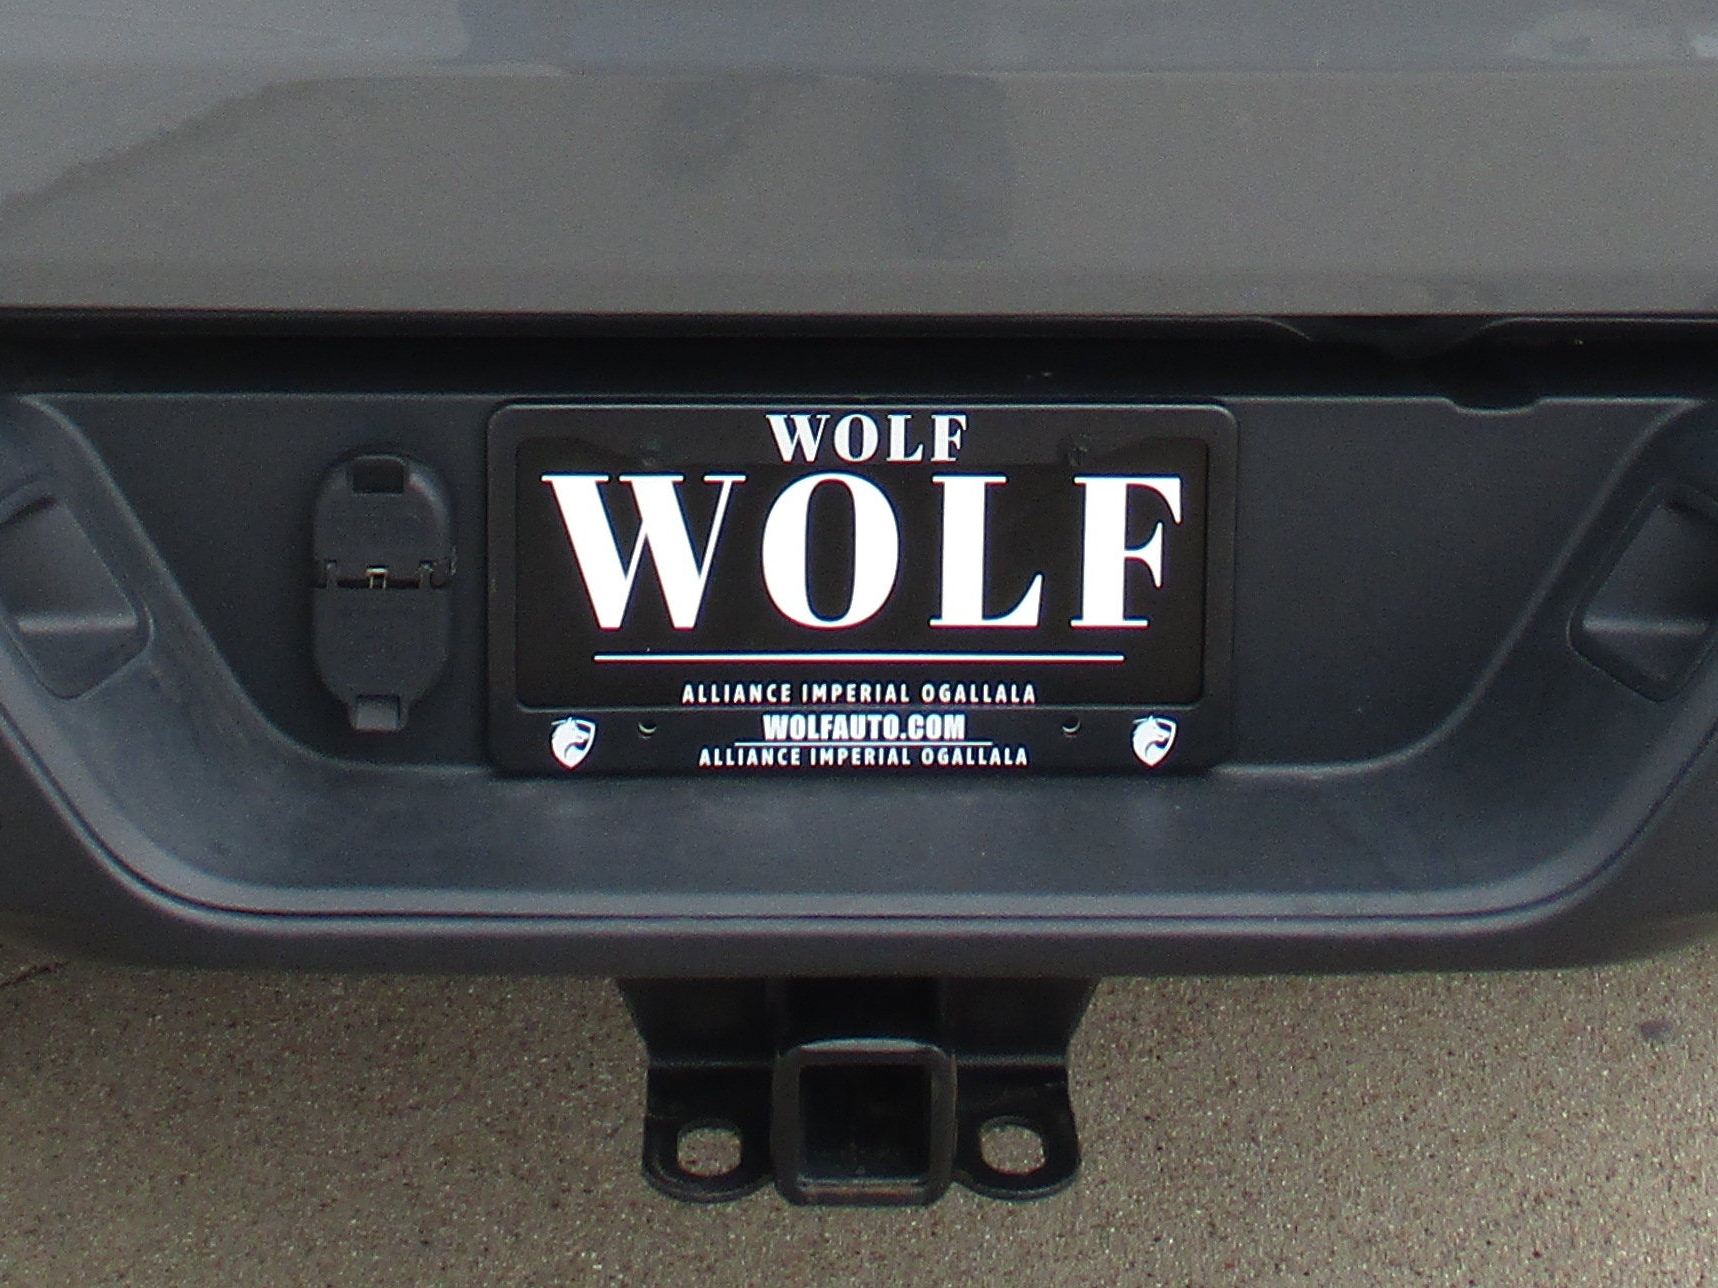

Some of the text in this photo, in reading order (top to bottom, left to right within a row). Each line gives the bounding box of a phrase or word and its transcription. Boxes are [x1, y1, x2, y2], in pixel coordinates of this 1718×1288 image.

[766, 413, 968, 463] WOLF
[541, 473, 1182, 630] WOLF
[682, 683, 1036, 704] ALLIANCE IMPERIAL OGALLALA
[762, 713, 966, 740] WOLFAUTO.COM
[698, 747, 1028, 766] ALLIANCE IMPERIAL OGALLALA
